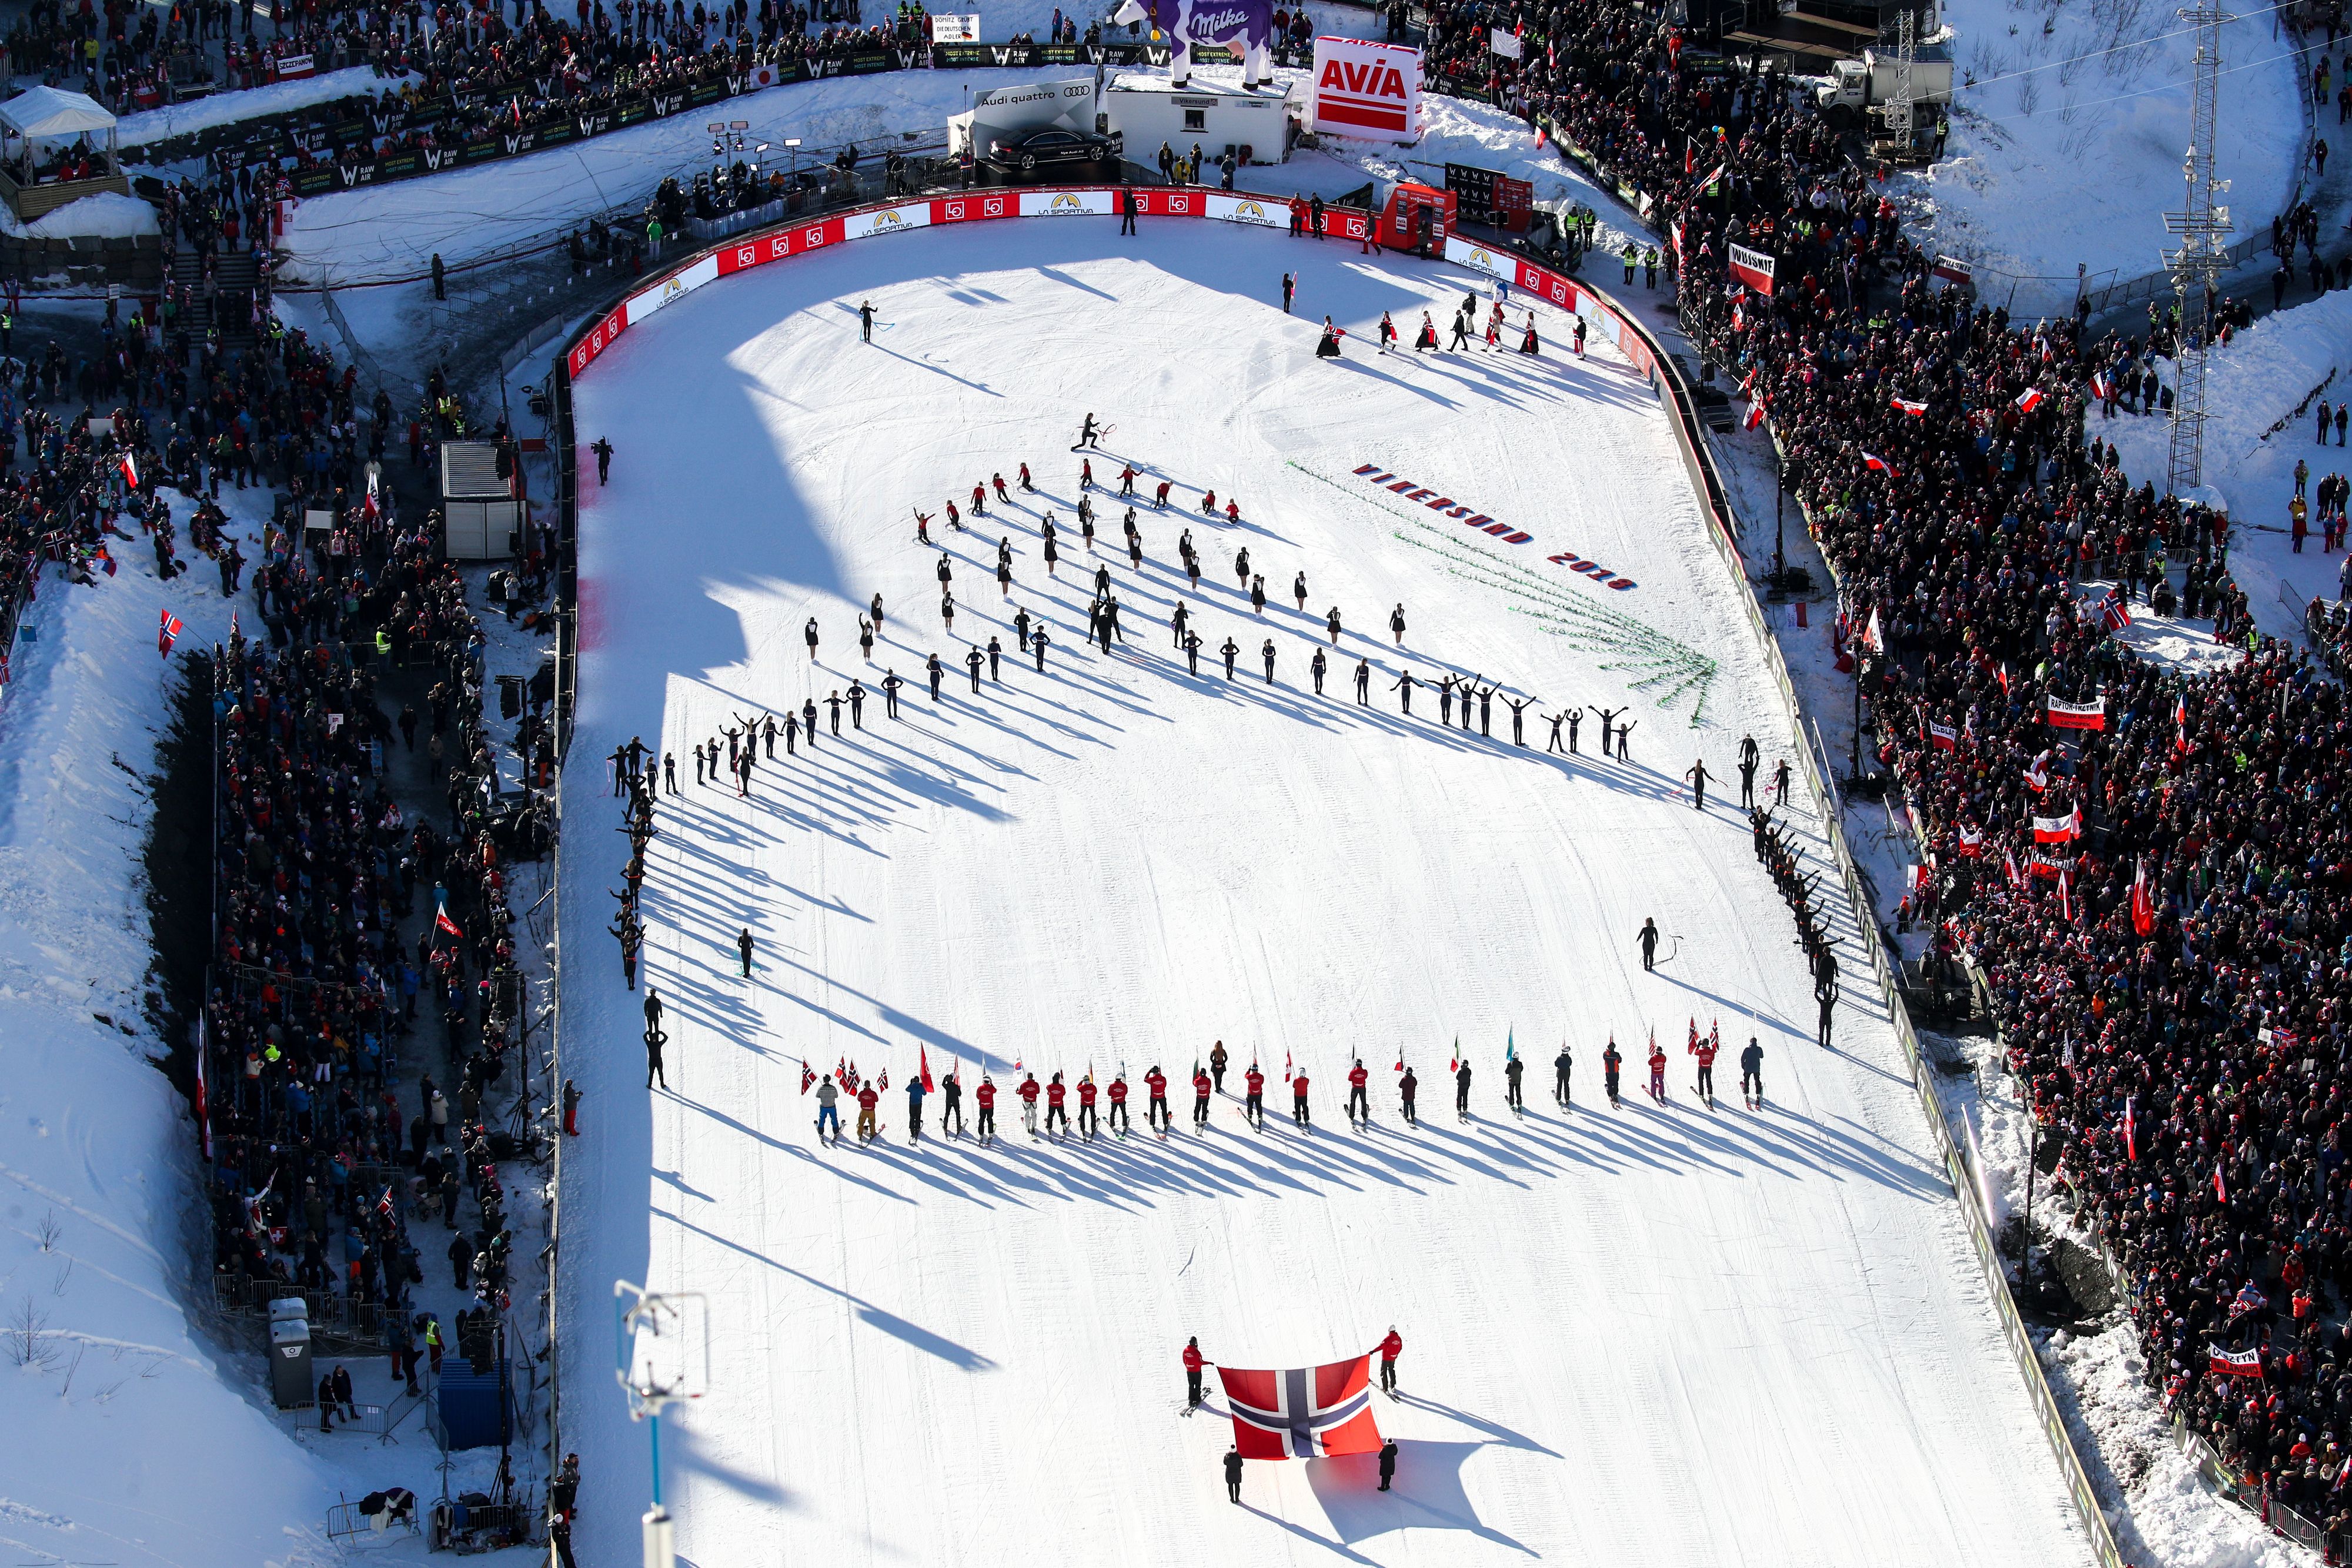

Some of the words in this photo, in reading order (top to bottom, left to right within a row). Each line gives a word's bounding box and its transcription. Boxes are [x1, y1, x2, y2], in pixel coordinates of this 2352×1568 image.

[1191, 8, 1249, 36] Milka
[827, 60, 842, 68] RAW
[1439, 79, 1452, 89] RAW
[702, 85, 719, 93] EXTREME
[473, 94, 487, 102] RAW
[670, 95, 683, 103] RAW
[703, 91, 718, 99] INTENSE
[981, 96, 1007, 107] Audi
[1011, 91, 1055, 105] quattro
[670, 103, 680, 111] AIR
[596, 115, 609, 124] RAW
[554, 125, 570, 133] EXTREME
[596, 123, 606, 132] AIR
[312, 133, 325, 142] RAW
[522, 134, 535, 142] RAW
[479, 142, 496, 151] EXTREME
[444, 149, 457, 158] RAW
[396, 157, 415, 166] EXTREME
[445, 158, 454, 166] AIR
[360, 165, 375, 174] RAW
[1235, 215, 1276, 226] SPORTIVA
[874, 223, 913, 234] SPORTIVA
[1732, 247, 1773, 273] WUJSKIE
[1469, 262, 1501, 277] SPORTIVA
[664, 287, 689, 304] SPORTIVA
[1352, 464, 1531, 543] VIKERSUND
[1547, 552, 1635, 590] 2018
